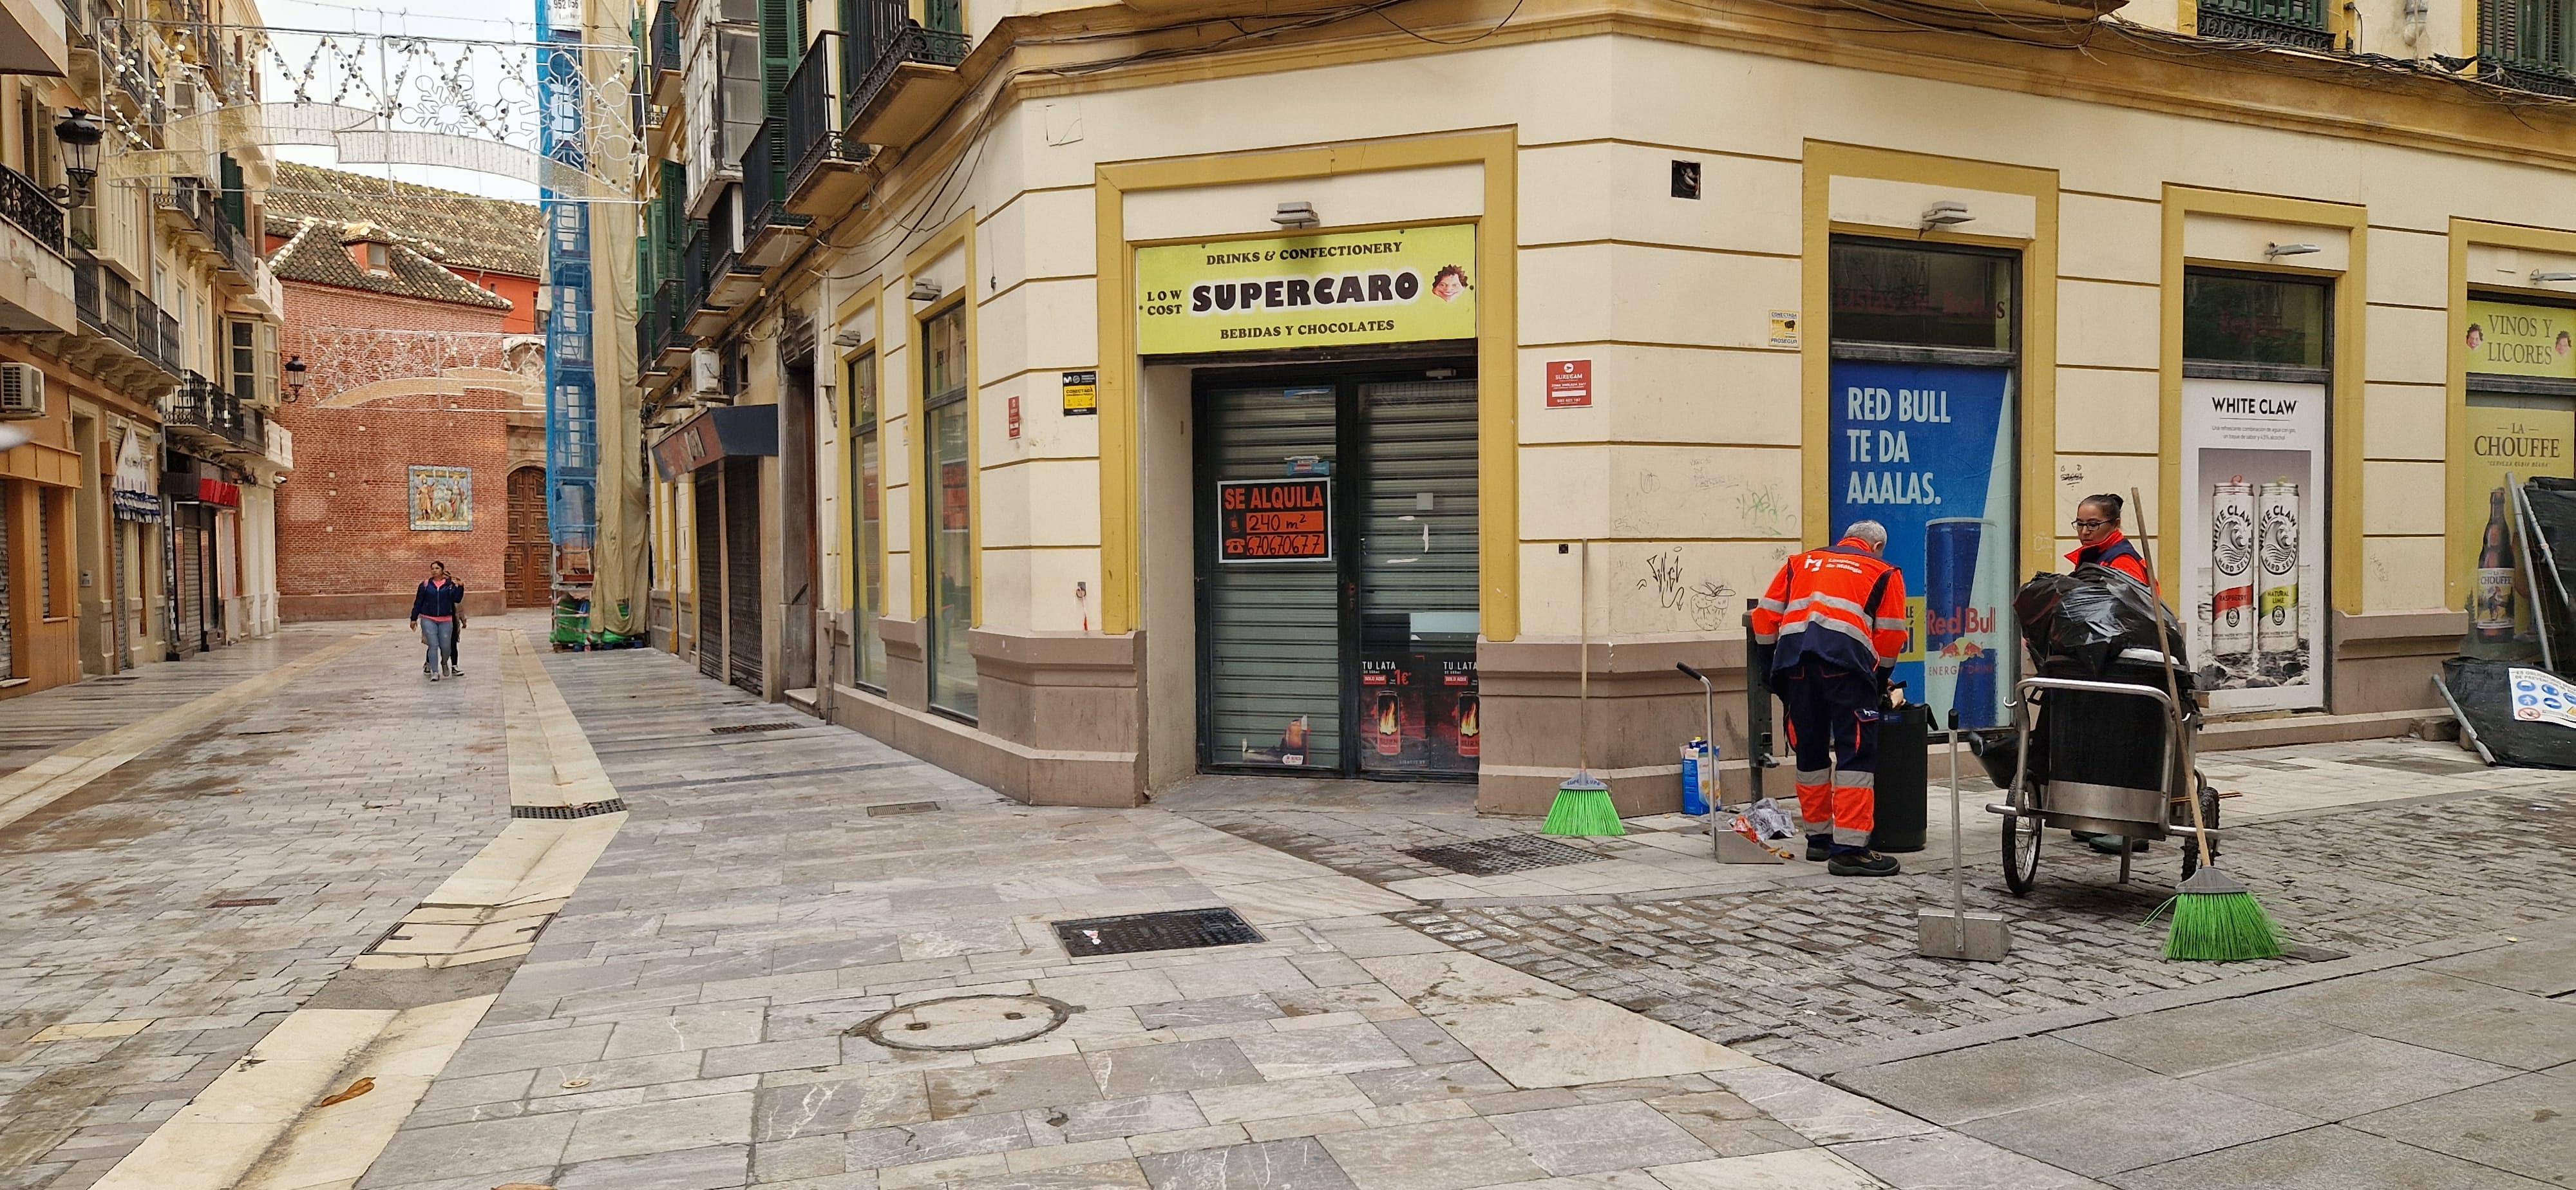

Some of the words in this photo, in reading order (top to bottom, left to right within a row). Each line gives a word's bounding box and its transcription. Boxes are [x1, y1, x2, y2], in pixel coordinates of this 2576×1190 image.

[1206, 252, 1260, 265] DRINKS
[1264, 250, 1276, 261] &
[1280, 241, 1403, 260] CONFECTIONERY
[1147, 290, 1182, 301] LOW
[1192, 272, 1419, 312] SUPERCARO
[1147, 305, 1182, 316] COST
[1220, 326, 1282, 339] BEBIDAS
[1284, 326, 1294, 336] Y
[1298, 320, 1394, 335] CHOCOLATES
[2488, 315, 2537, 337] VINOS
[2543, 319, 2553, 337] Y
[2488, 342, 2552, 365] LICORES
[1848, 387, 1891, 420] RED
[1899, 389, 1951, 423] BULL
[2211, 397, 2255, 414] WHITE
[2259, 399, 2297, 415] CLAW
[2512, 422, 2524, 434] LA
[1846, 430, 1871, 462] TE
[1879, 430, 1910, 463] DA
[2474, 435, 2561, 458] CHOUFFE
[1225, 487, 1245, 510] SE
[1250, 486, 1323, 509] ALQUILA
[1846, 471, 1942, 505] AAALAS.
[1249, 514, 1281, 531] 240
[2213, 509, 2226, 552] WHITE
[2227, 504, 2251, 527] CLAW
[2259, 509, 2272, 552] WHITE
[2273, 505, 2297, 527] CLAW
[1247, 534, 1320, 556] 670670677
[1927, 607, 1962, 635] Red
[1965, 607, 1996, 634] Bull
[1362, 661, 1372, 670] TU
[1376, 661, 1396, 670] LATA
[1443, 661, 1454, 670] TU
[1457, 661, 1477, 670] LATA
[1929, 665, 1963, 676] ENERGY
